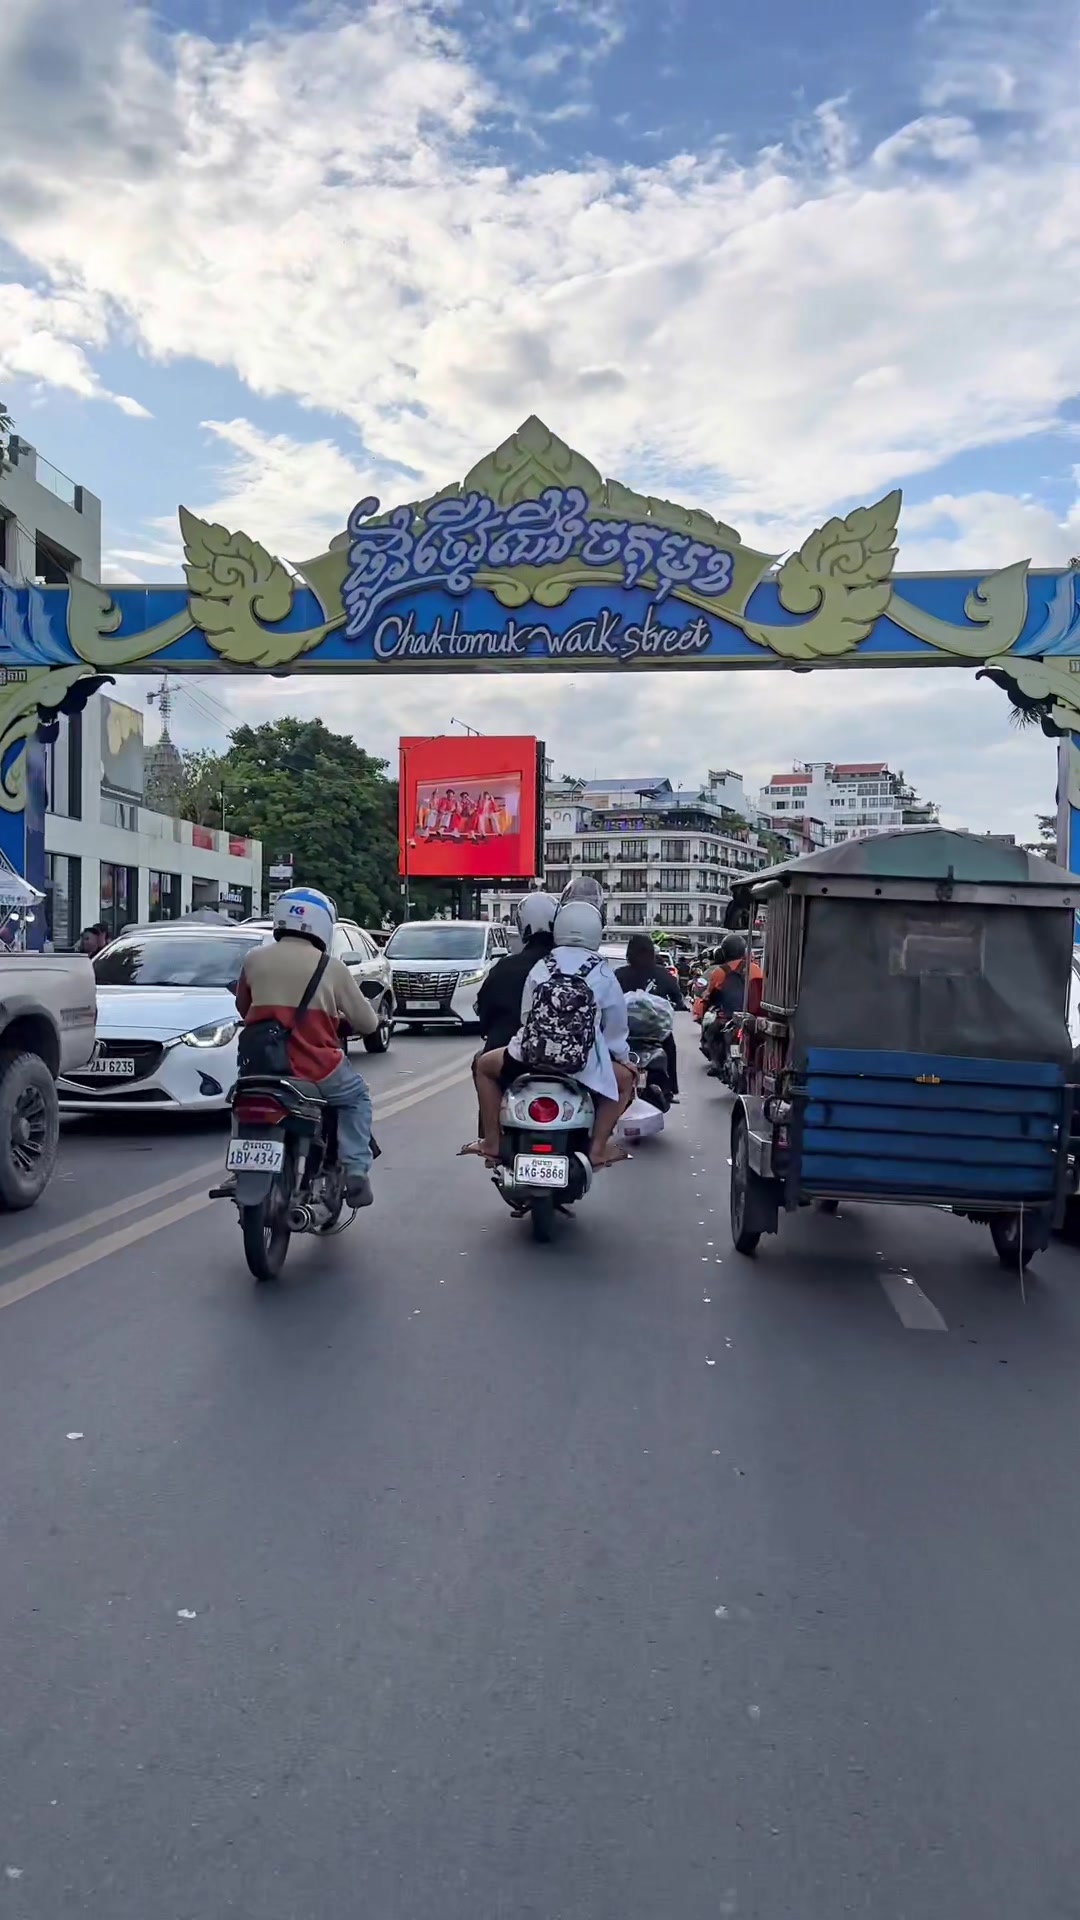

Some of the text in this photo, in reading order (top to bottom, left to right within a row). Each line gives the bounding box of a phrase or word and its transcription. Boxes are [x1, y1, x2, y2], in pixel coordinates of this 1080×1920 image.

[374, 609, 533, 658] Chaktomuk
[620, 605, 711, 659] street
[109, 1060, 133, 1073] 6235
